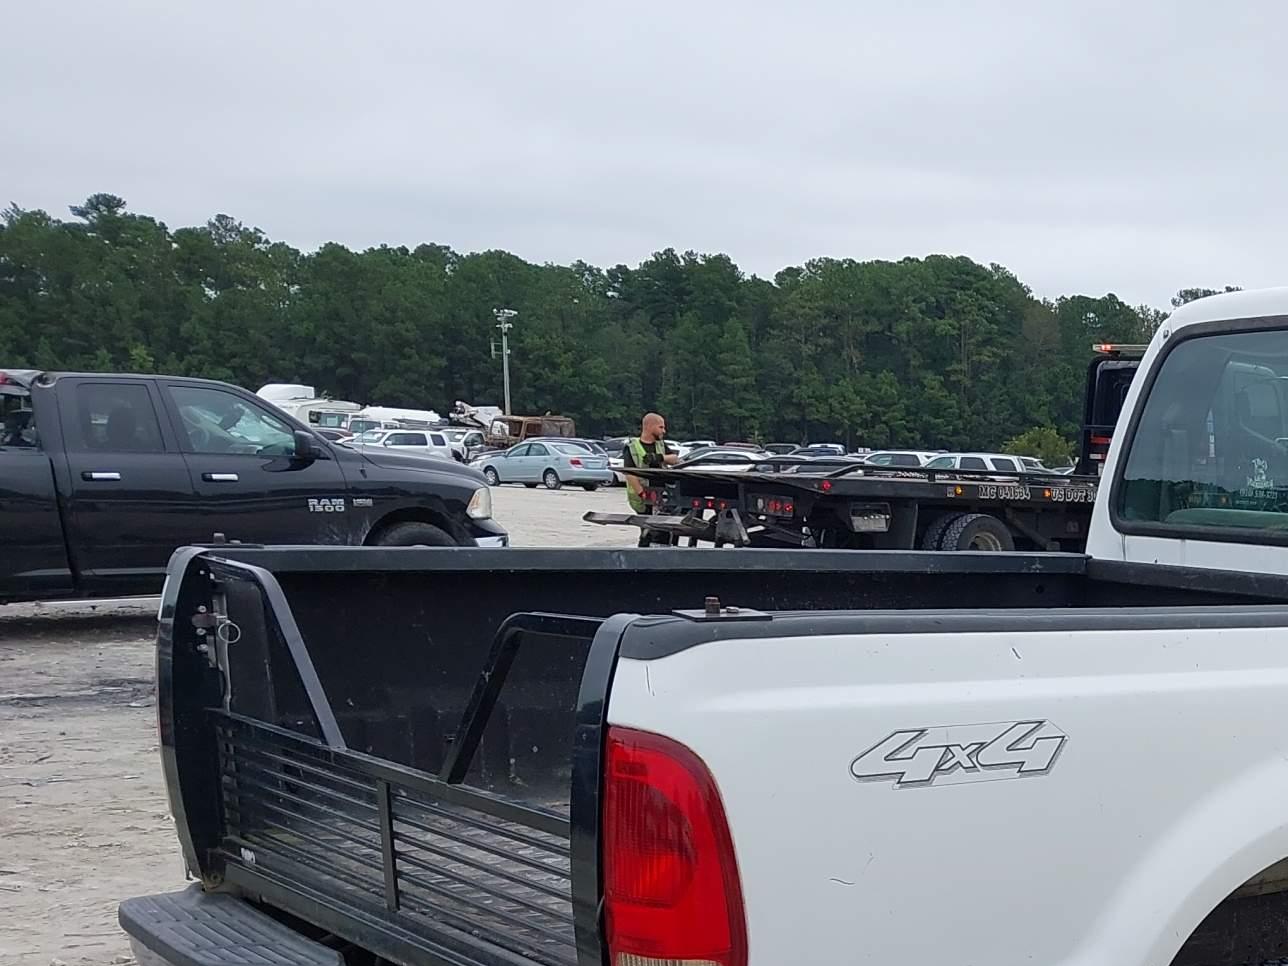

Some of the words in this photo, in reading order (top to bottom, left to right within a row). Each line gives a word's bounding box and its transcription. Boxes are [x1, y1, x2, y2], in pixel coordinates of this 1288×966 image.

[978, 485, 997, 500] MC
[1051, 487, 1065, 502] US
[1066, 488, 1086, 503] DOT
[308, 498, 345, 506] RAM
[848, 719, 1070, 786] 4x4
